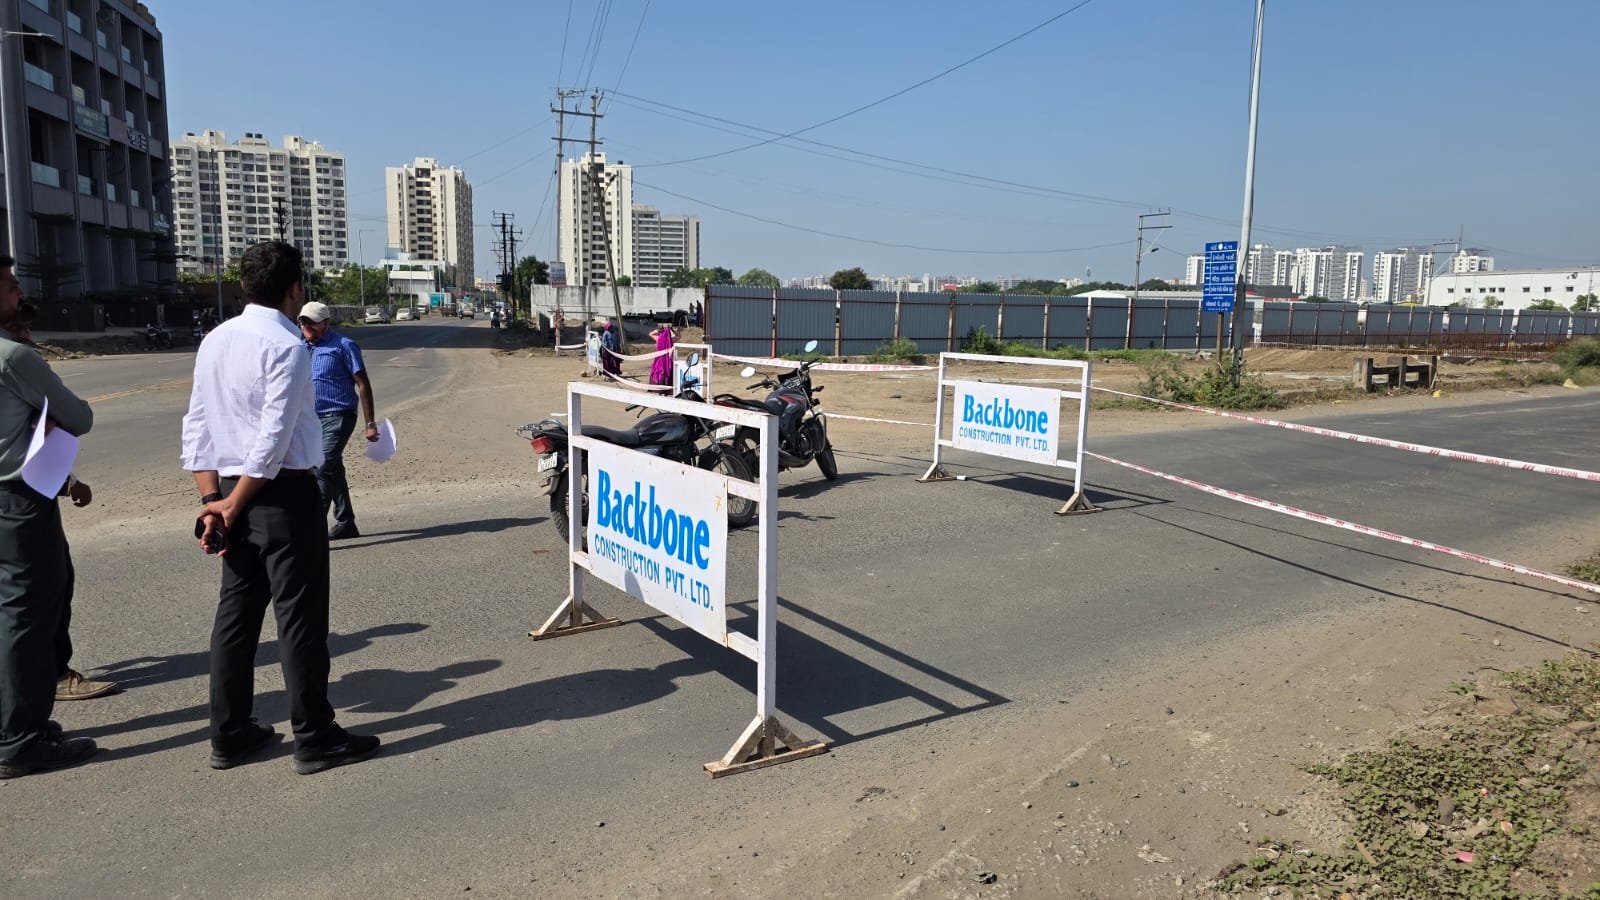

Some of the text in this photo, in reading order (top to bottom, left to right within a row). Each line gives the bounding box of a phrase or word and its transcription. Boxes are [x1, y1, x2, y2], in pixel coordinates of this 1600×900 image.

[959, 427, 1050, 452] CONSTRUCTION PVT. LTD.
[963, 394, 1048, 434] Backbone
[597, 469, 710, 570] Backbone
[594, 533, 713, 611] CONSTRUCTION PVT. LTD.
